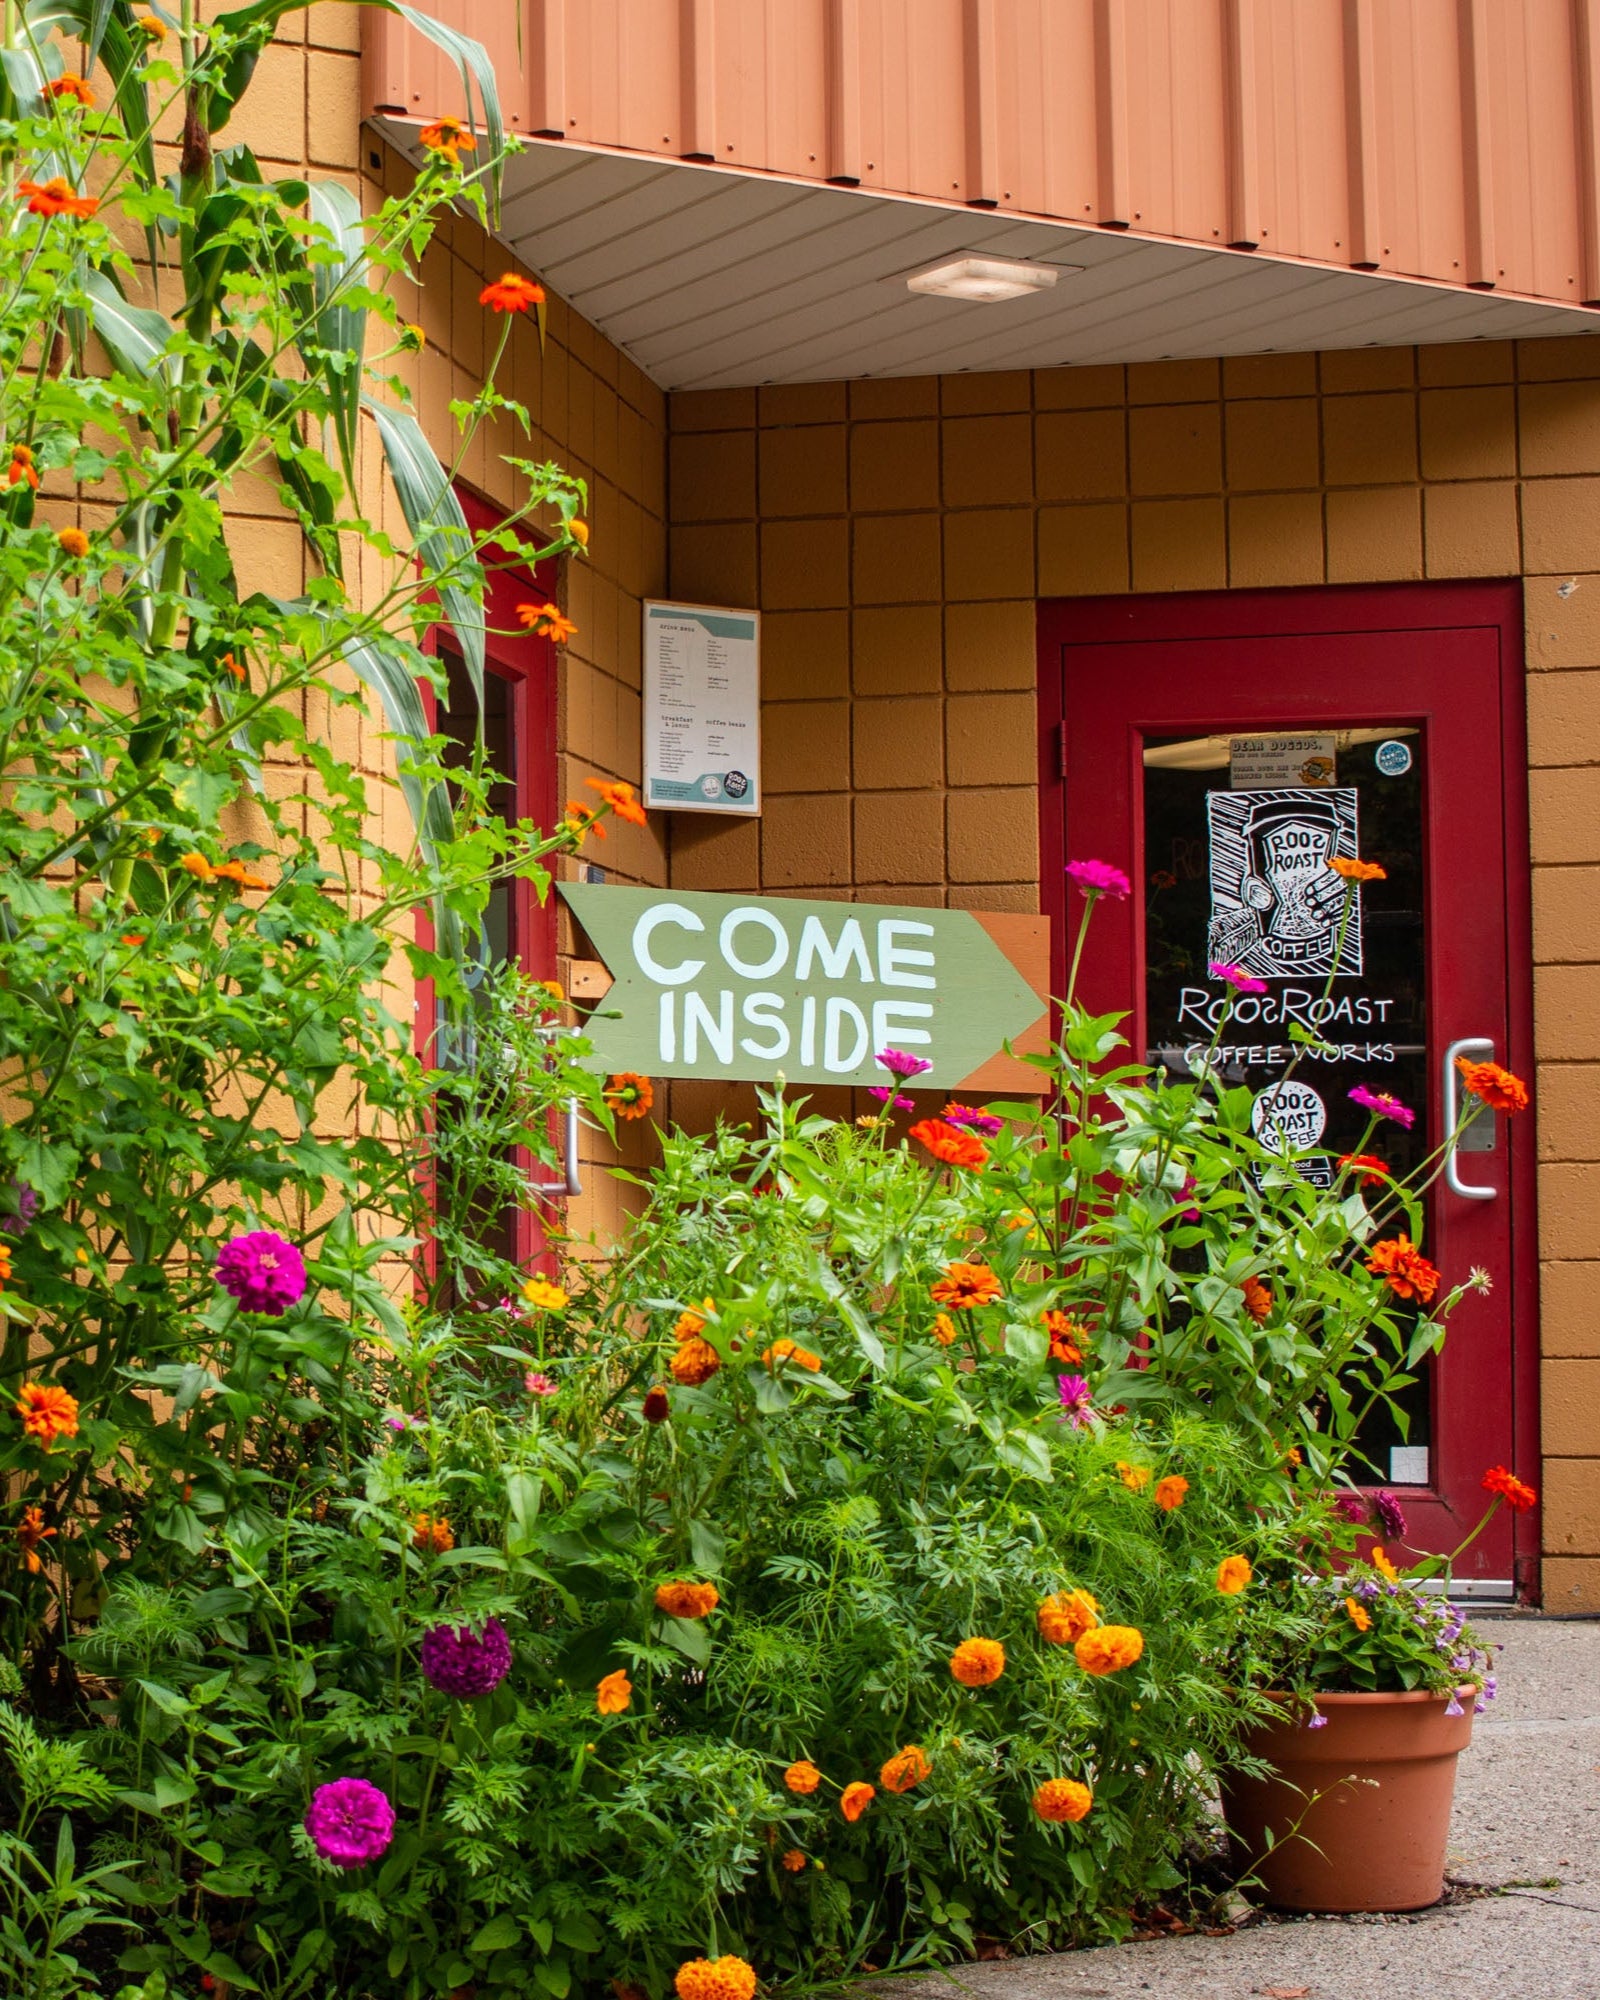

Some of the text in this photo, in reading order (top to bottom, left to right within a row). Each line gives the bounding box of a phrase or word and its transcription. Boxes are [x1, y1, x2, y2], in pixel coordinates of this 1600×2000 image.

[1232, 741, 1264, 752] DEAR
[1274, 852, 1324, 873] ROAST
[633, 903, 936, 990] COME
[1261, 935, 1332, 959] COFFEE
[658, 989, 934, 1073] INSIDE
[1183, 1042, 1286, 1065] COFFEE
[1291, 1042, 1395, 1064] WORKS
[1262, 1112, 1318, 1134] ROAST
